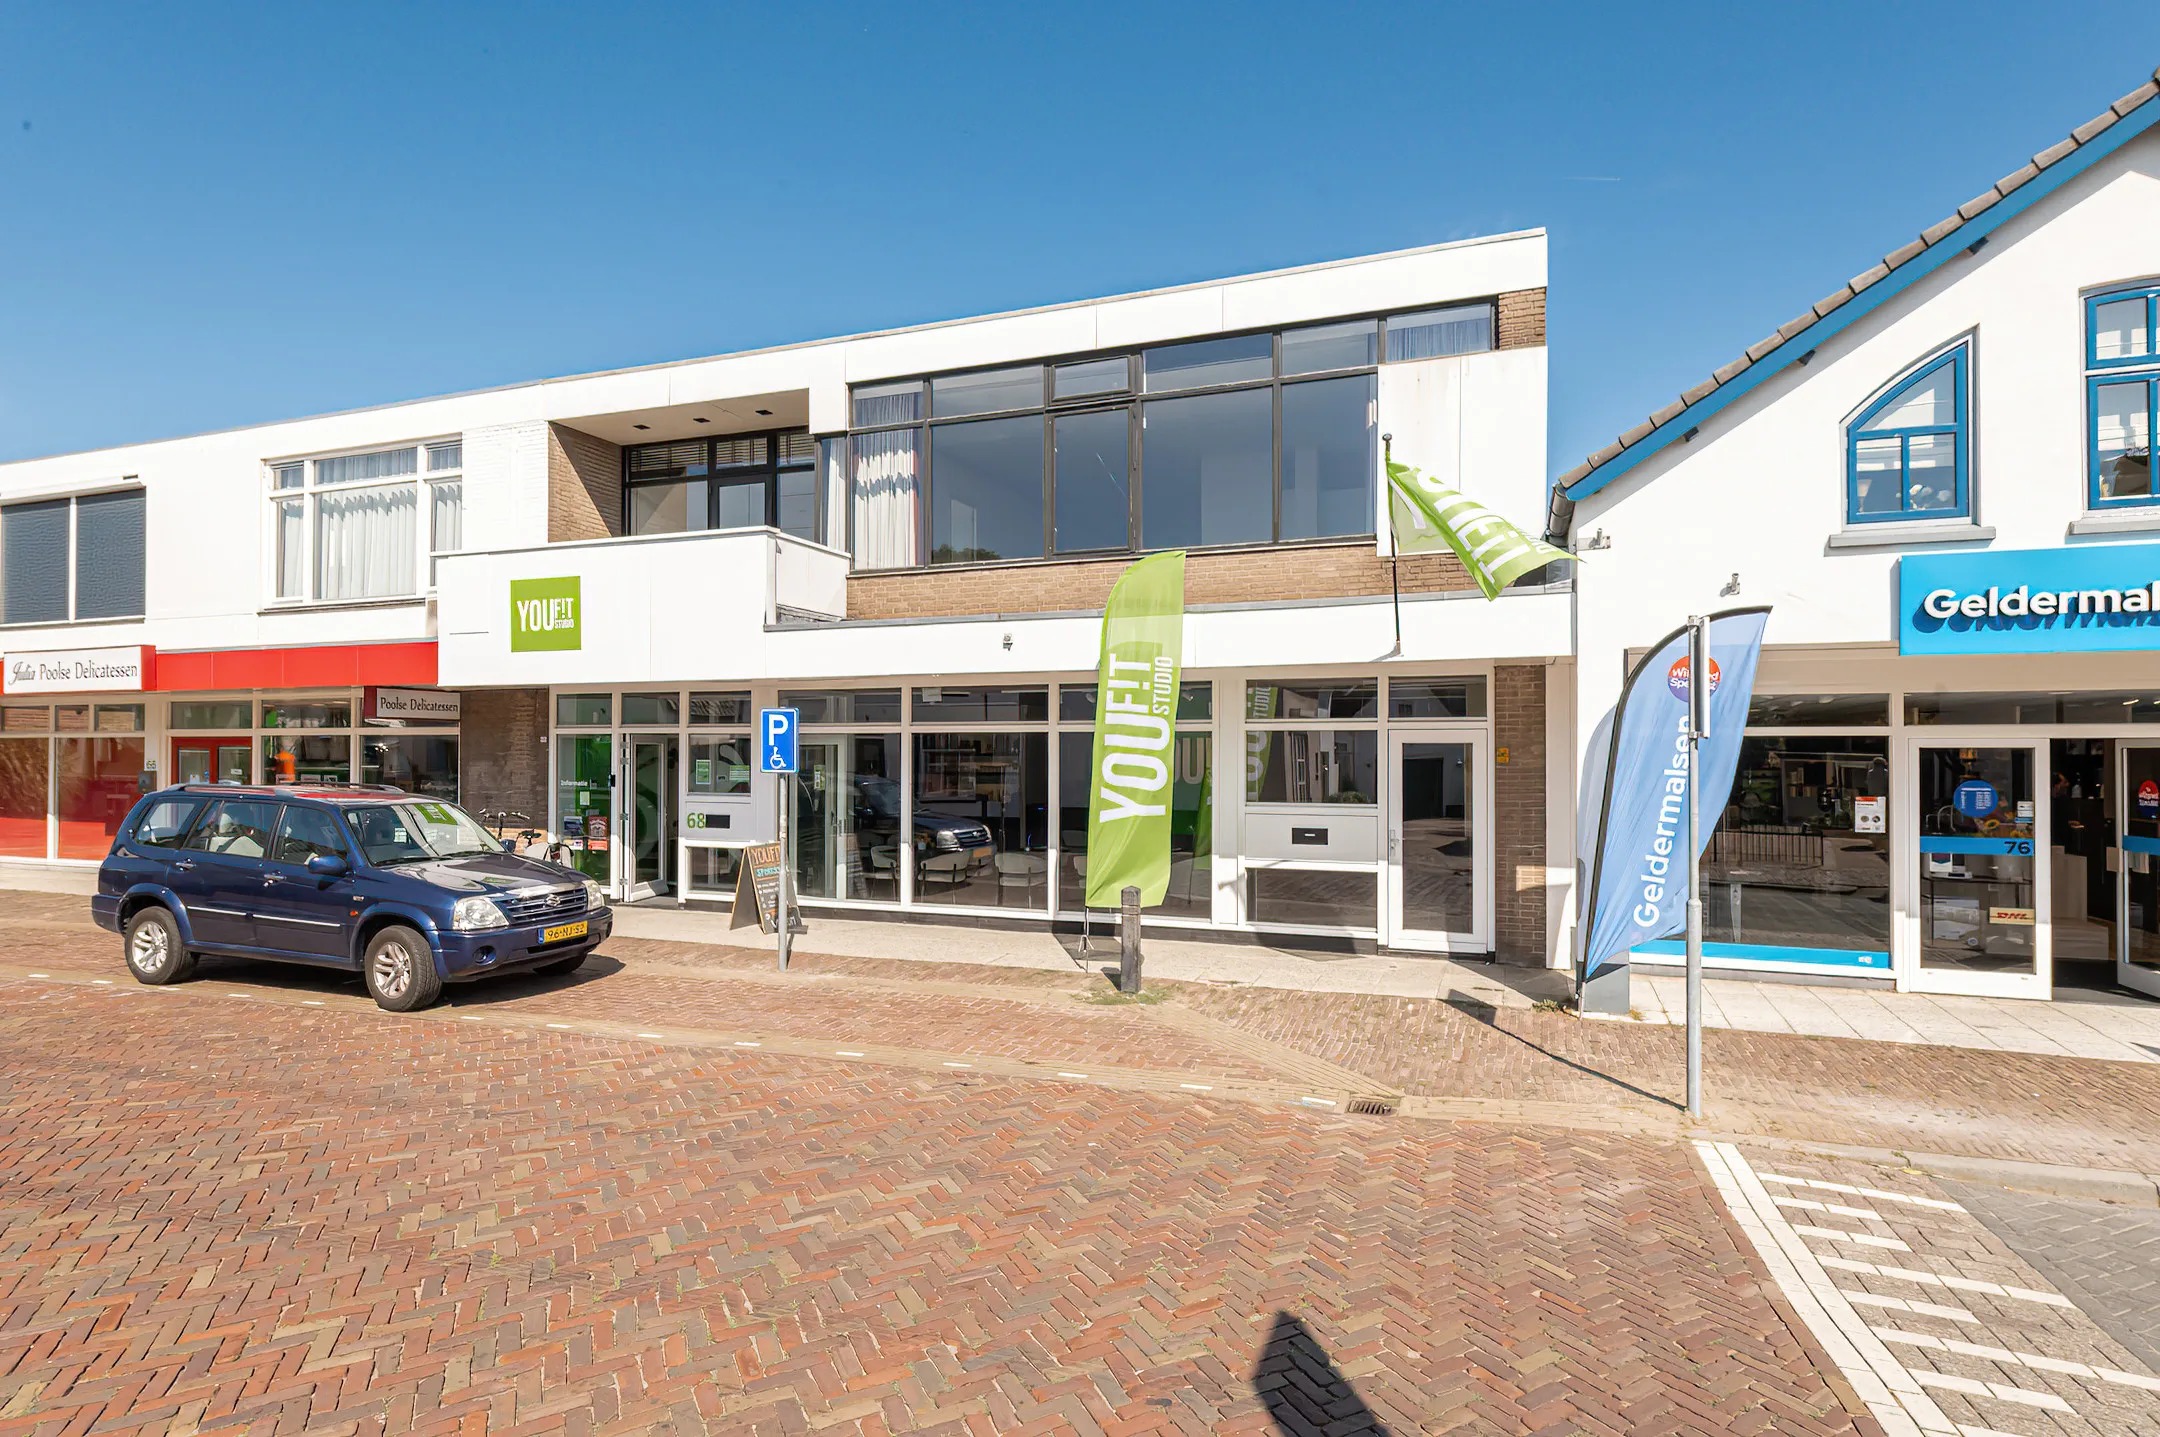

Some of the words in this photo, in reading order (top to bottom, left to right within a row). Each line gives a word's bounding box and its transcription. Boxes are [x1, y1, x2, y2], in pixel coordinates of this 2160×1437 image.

[39, 661, 71, 680] Poolse
[75, 660, 138, 679] Delicatessen
[1152, 656, 1174, 716] STUDIO
[380, 697, 407, 710] Poolse
[410, 698, 459, 713] Delicatessen
[768, 713, 789, 746] P
[687, 812, 705, 829] 68
[1632, 715, 1691, 928] Geldermalsen
[2003, 841, 2031, 854] 76
